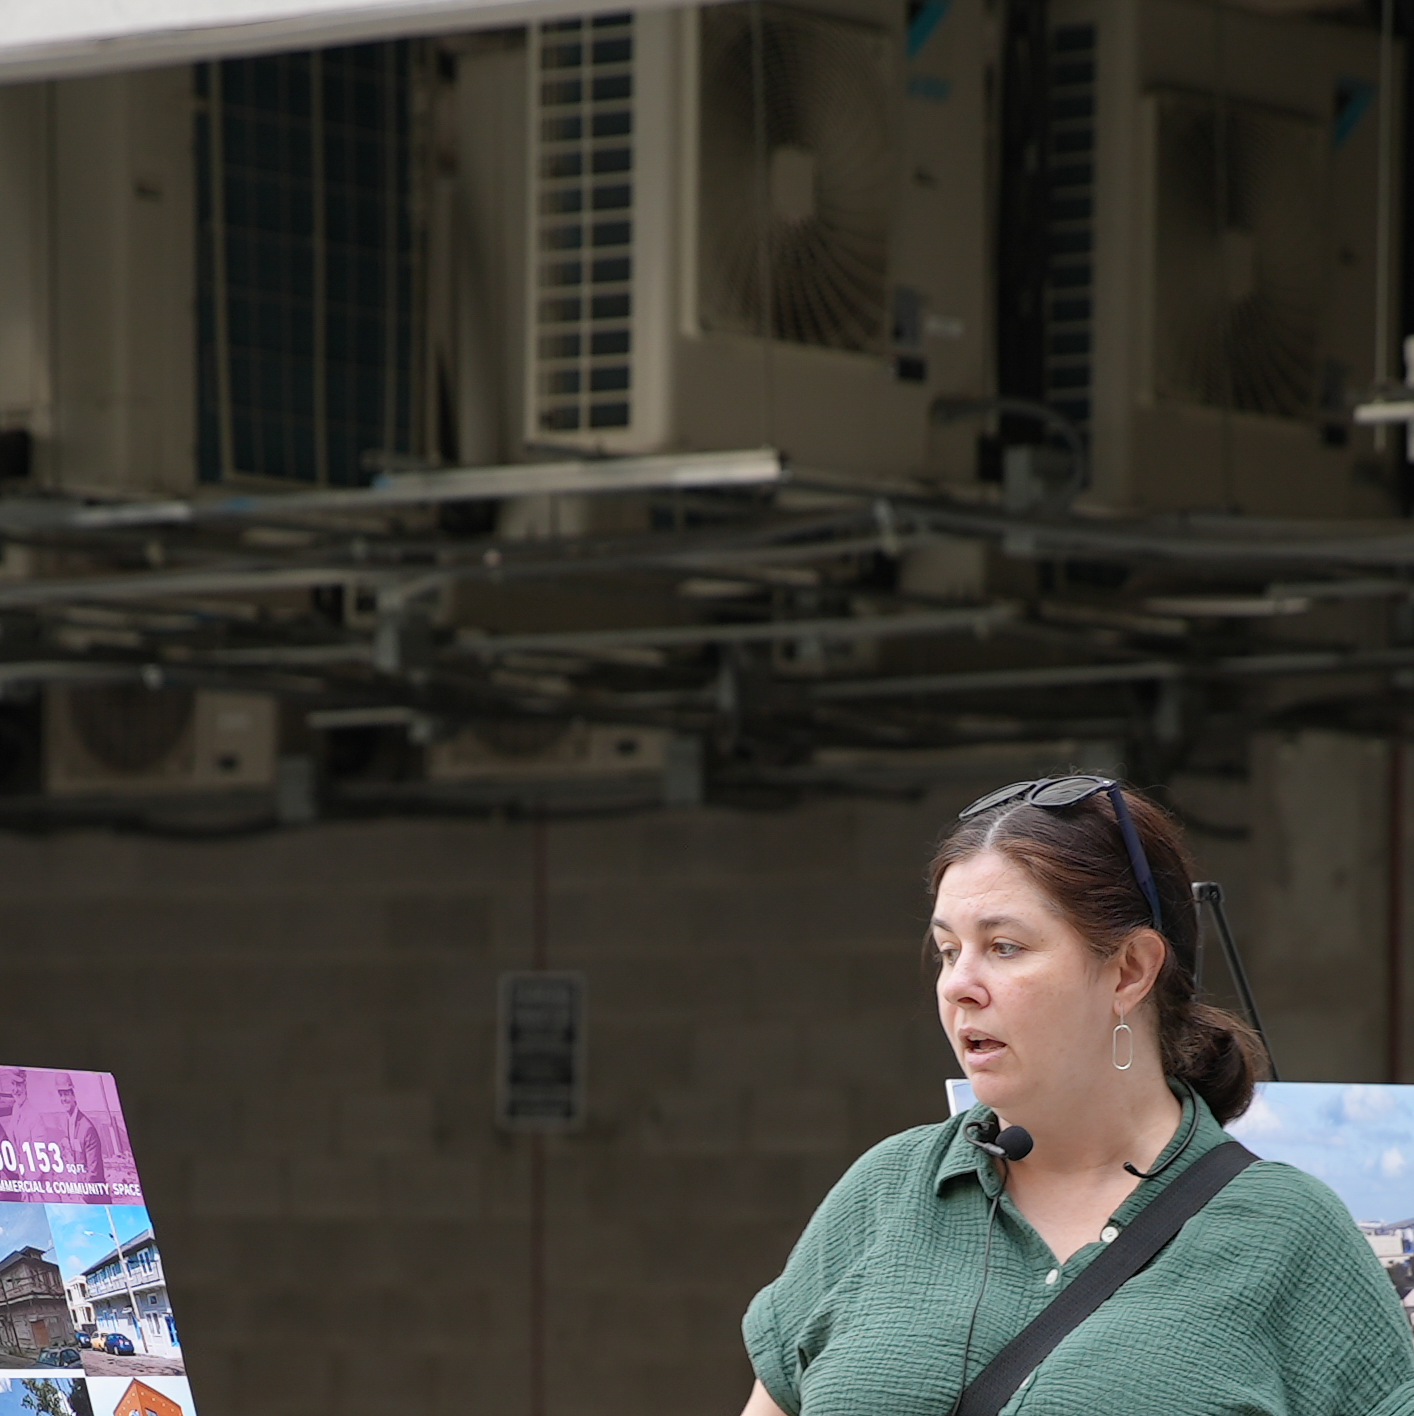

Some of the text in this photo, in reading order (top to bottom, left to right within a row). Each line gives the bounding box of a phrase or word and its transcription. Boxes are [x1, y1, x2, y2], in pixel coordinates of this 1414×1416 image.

[45, 1183, 54, 1193] &
[53, 1181, 110, 1196] COMMUNITY
[114, 1184, 141, 1197] SPACE
